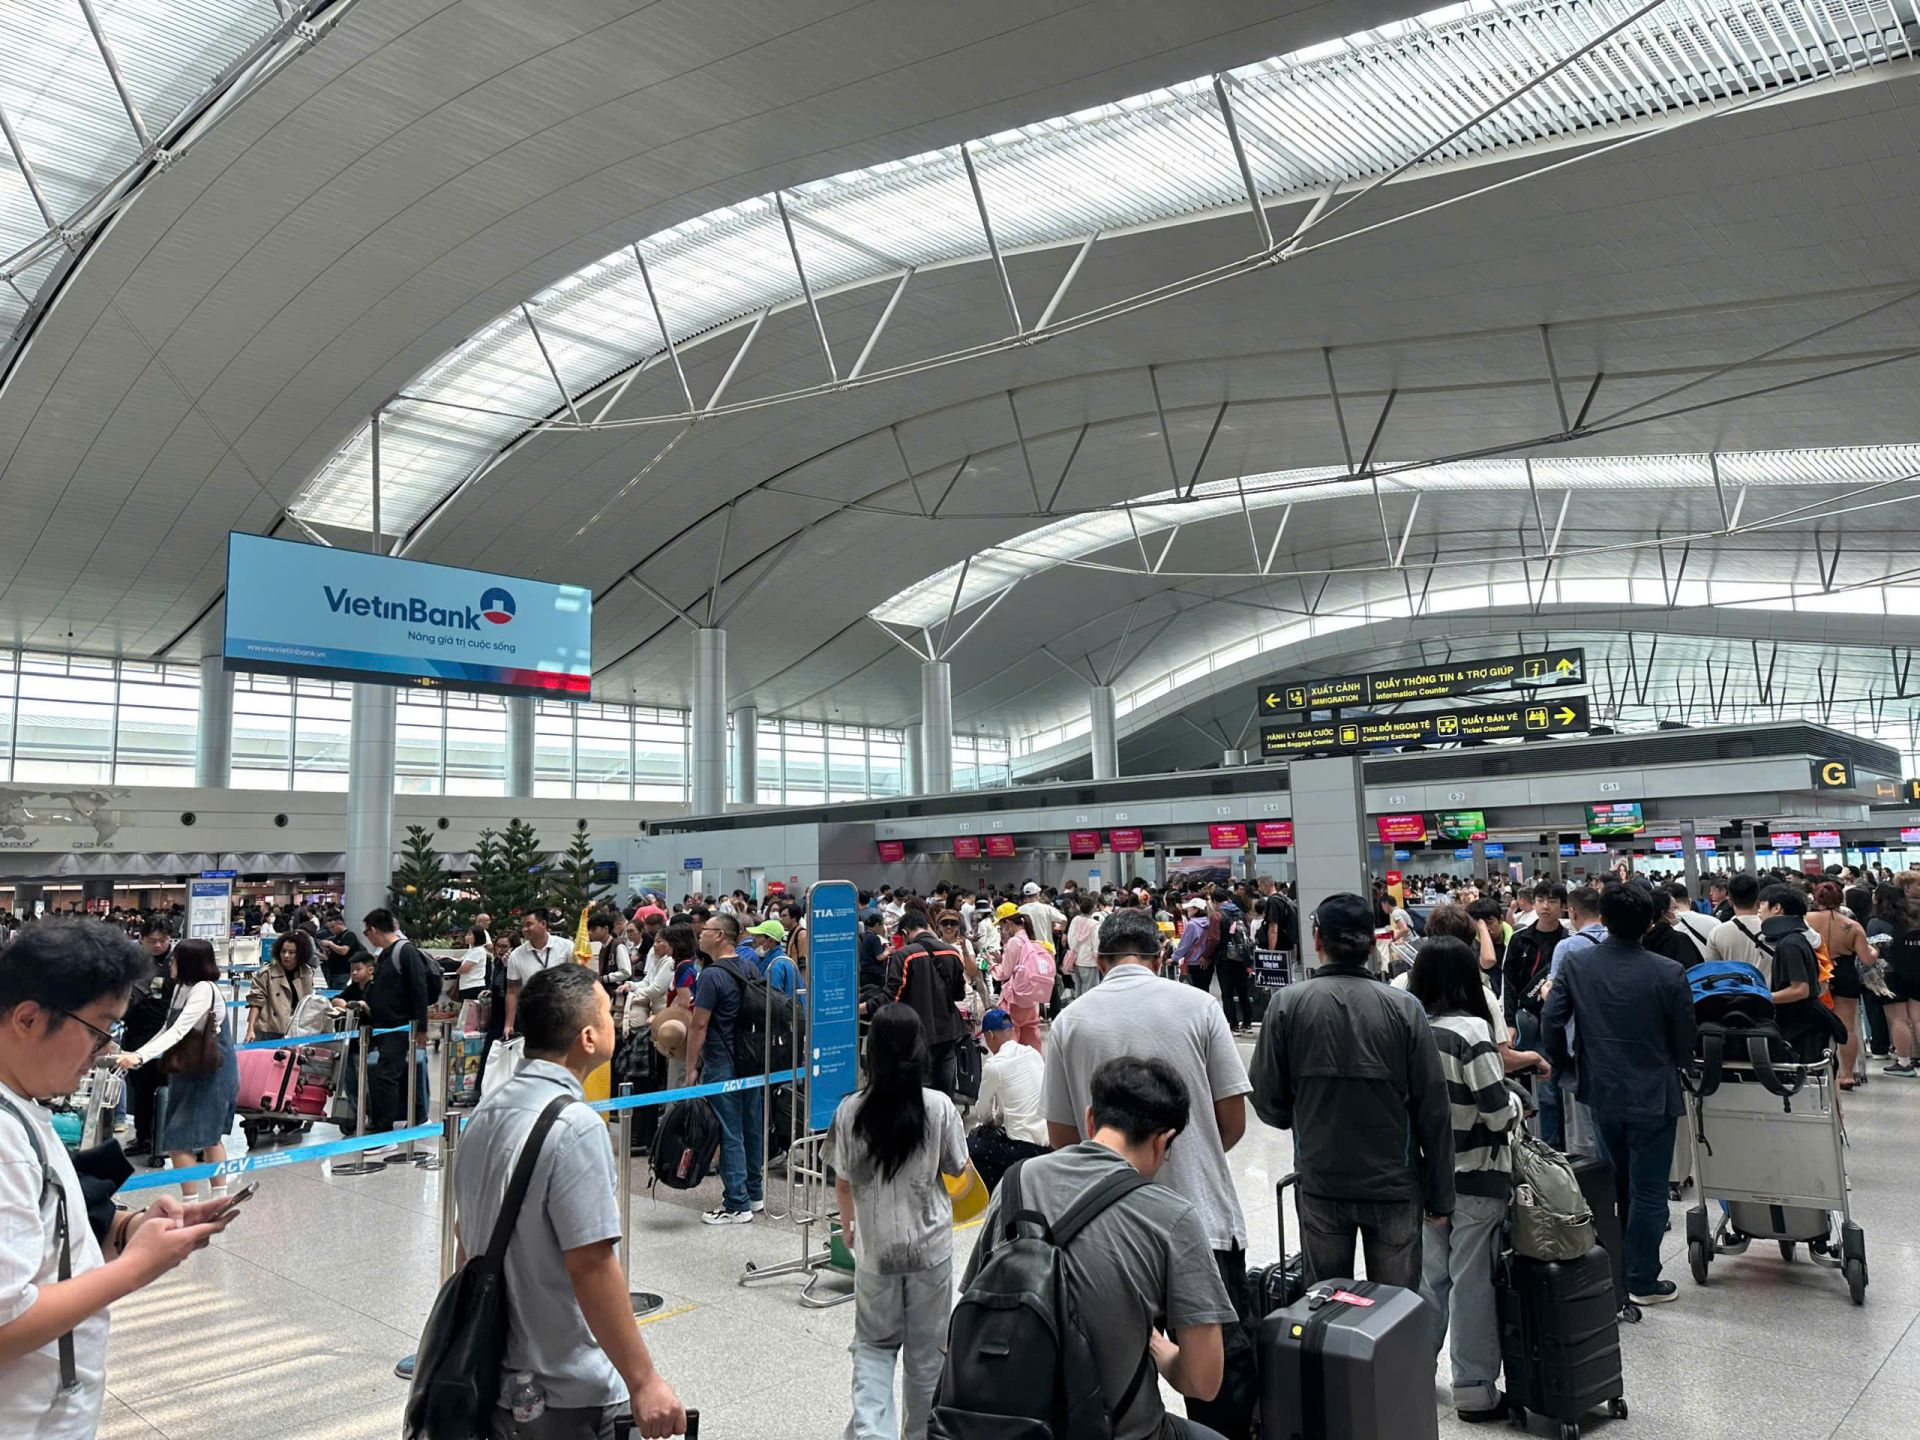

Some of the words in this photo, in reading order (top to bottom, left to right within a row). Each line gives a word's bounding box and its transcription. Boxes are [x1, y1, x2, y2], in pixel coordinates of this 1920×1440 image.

[323, 585, 481, 631] VietinBank
[408, 631, 435, 645] Nâng
[437, 632, 453, 646] giá
[455, 637, 466, 648] trị
[467, 639, 491, 650] cuộc
[493, 640, 516, 653] sống
[1403, 674, 1436, 687] THÔNG
[1439, 672, 1455, 683] TIN
[1457, 671, 1464, 681] &
[1466, 668, 1488, 679] TRỢ
[1489, 665, 1514, 677] GIÚP
[1311, 683, 1334, 696] XUẤT
[1336, 681, 1361, 693] CẢNH
[1375, 688, 1418, 700] Information
[1419, 686, 1449, 696] Counter
[1311, 694, 1359, 706] IMMIGRATION
[1486, 712, 1505, 724] BÁN
[1362, 725, 1378, 734] THU
[1393, 722, 1419, 731] NGOẠI
[1462, 726, 1483, 735] Ticket
[1484, 724, 1510, 733] Counter
[1362, 734, 1390, 742] Currency
[1822, 762, 1847, 786] G
[813, 909, 834, 918] TIA
[1527, 978, 1546, 998] Reebok
[334, 1030, 352, 1040] ACV
[722, 1080, 743, 1092] ACV
[213, 1157, 251, 1176] ACV
